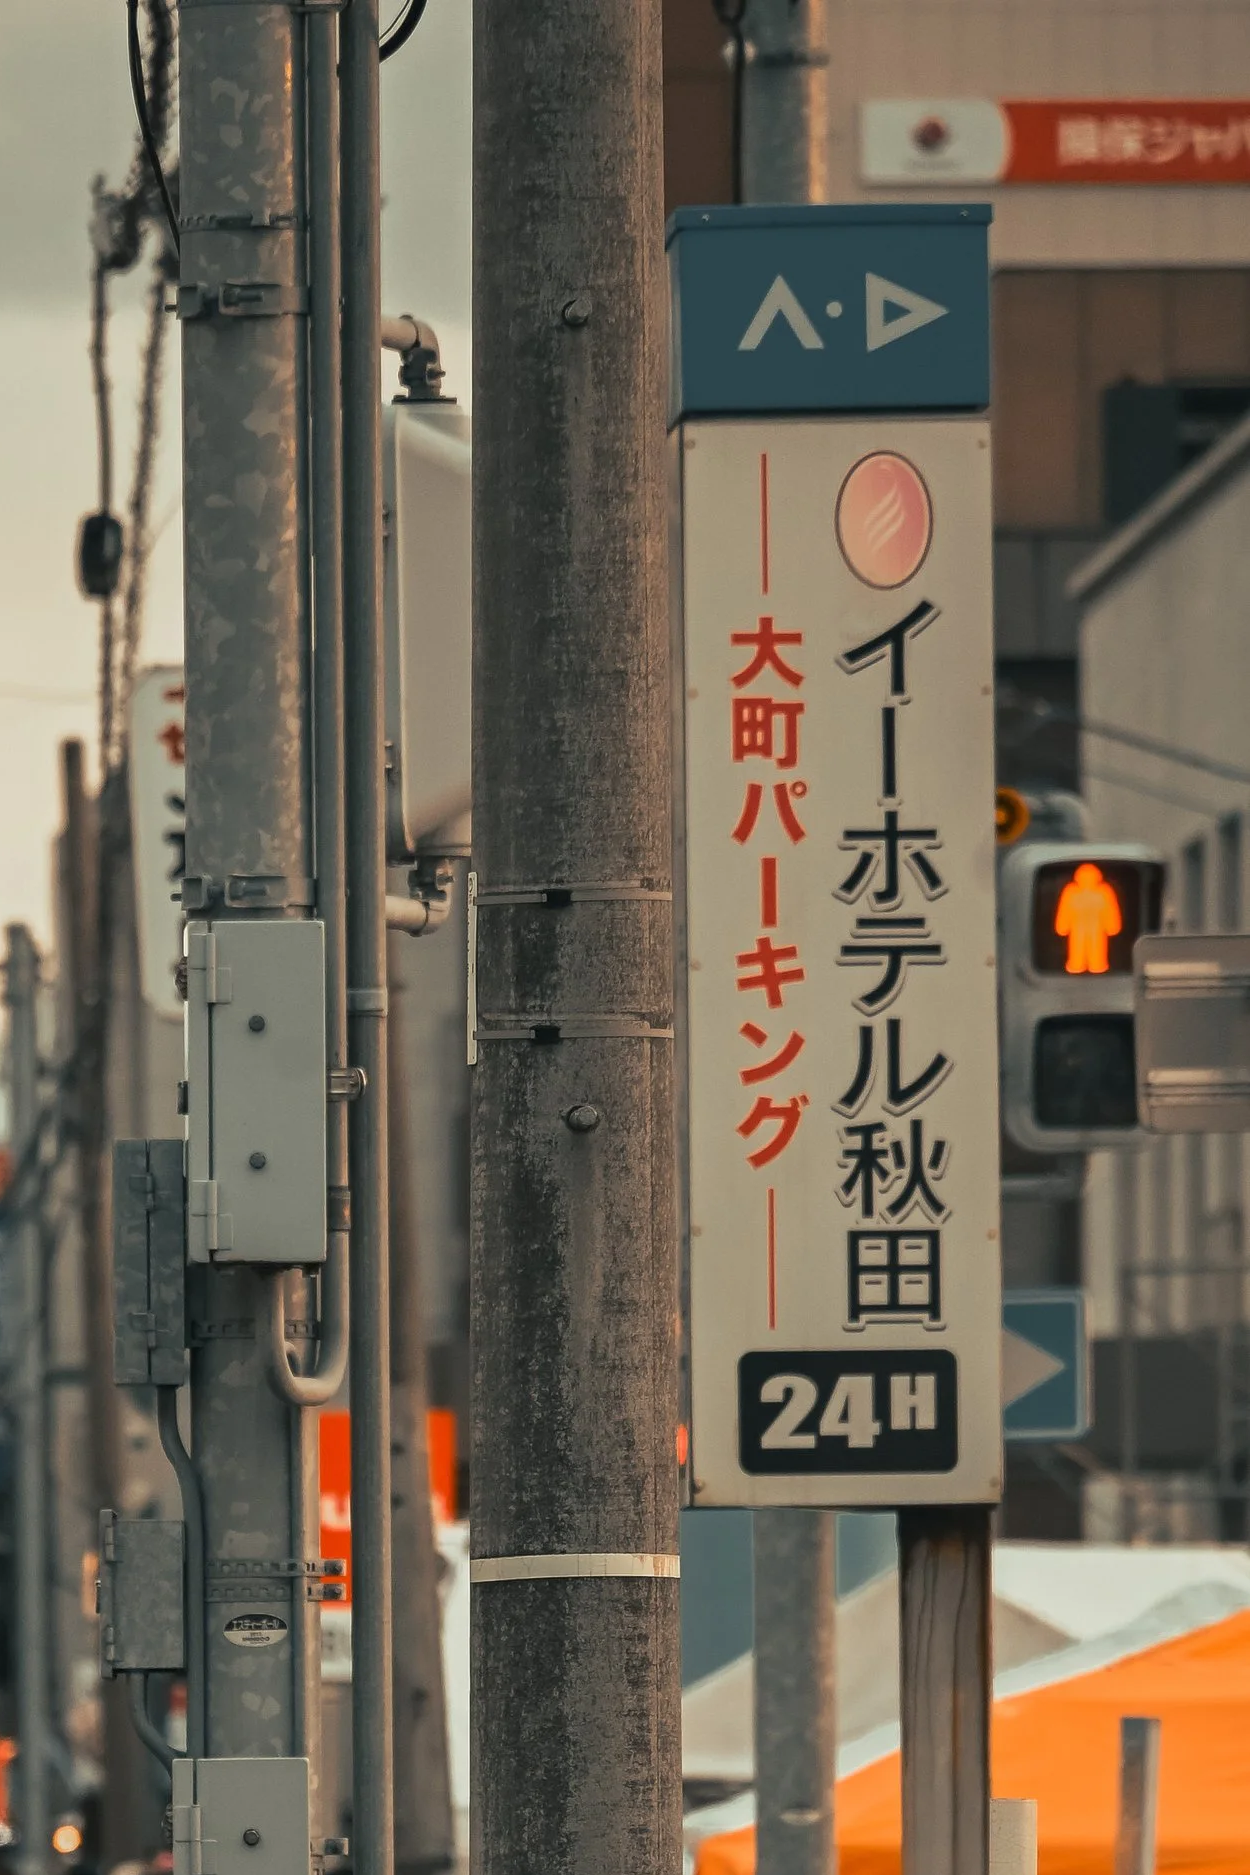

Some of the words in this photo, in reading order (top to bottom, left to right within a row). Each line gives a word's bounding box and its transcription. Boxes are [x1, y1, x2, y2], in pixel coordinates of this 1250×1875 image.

[730, 616, 810, 1171] 大町パーキング
[833, 598, 953, 1330] イーホテル秋田
[759, 1373, 938, 1450] 24H
